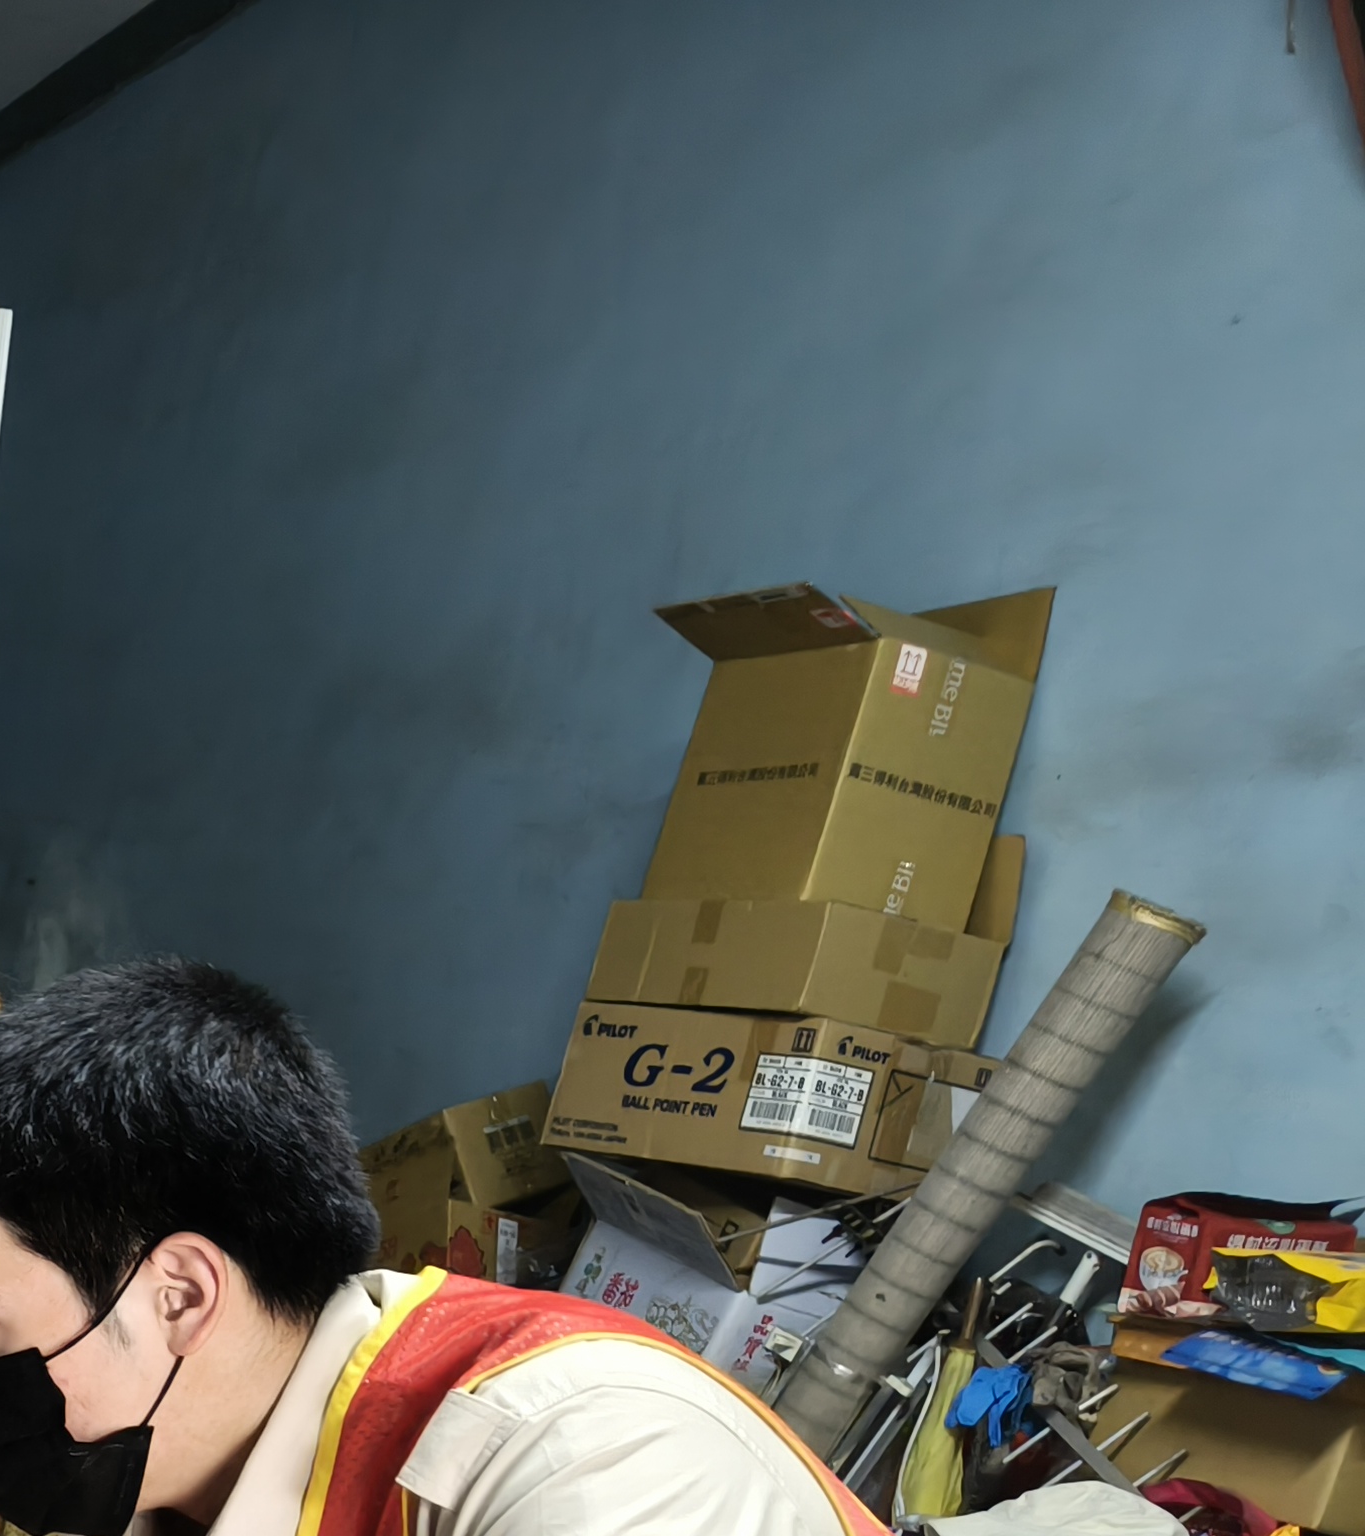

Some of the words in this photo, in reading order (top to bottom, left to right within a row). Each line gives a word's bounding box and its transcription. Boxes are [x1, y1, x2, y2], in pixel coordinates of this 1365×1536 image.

[597, 1022, 638, 1039] PILOT
[852, 1044, 891, 1066] PILOT
[623, 1043, 736, 1094] G-2
[621, 1094, 650, 1111] BALL
[652, 1098, 690, 1115] POINT
[689, 1101, 718, 1118] PEN
